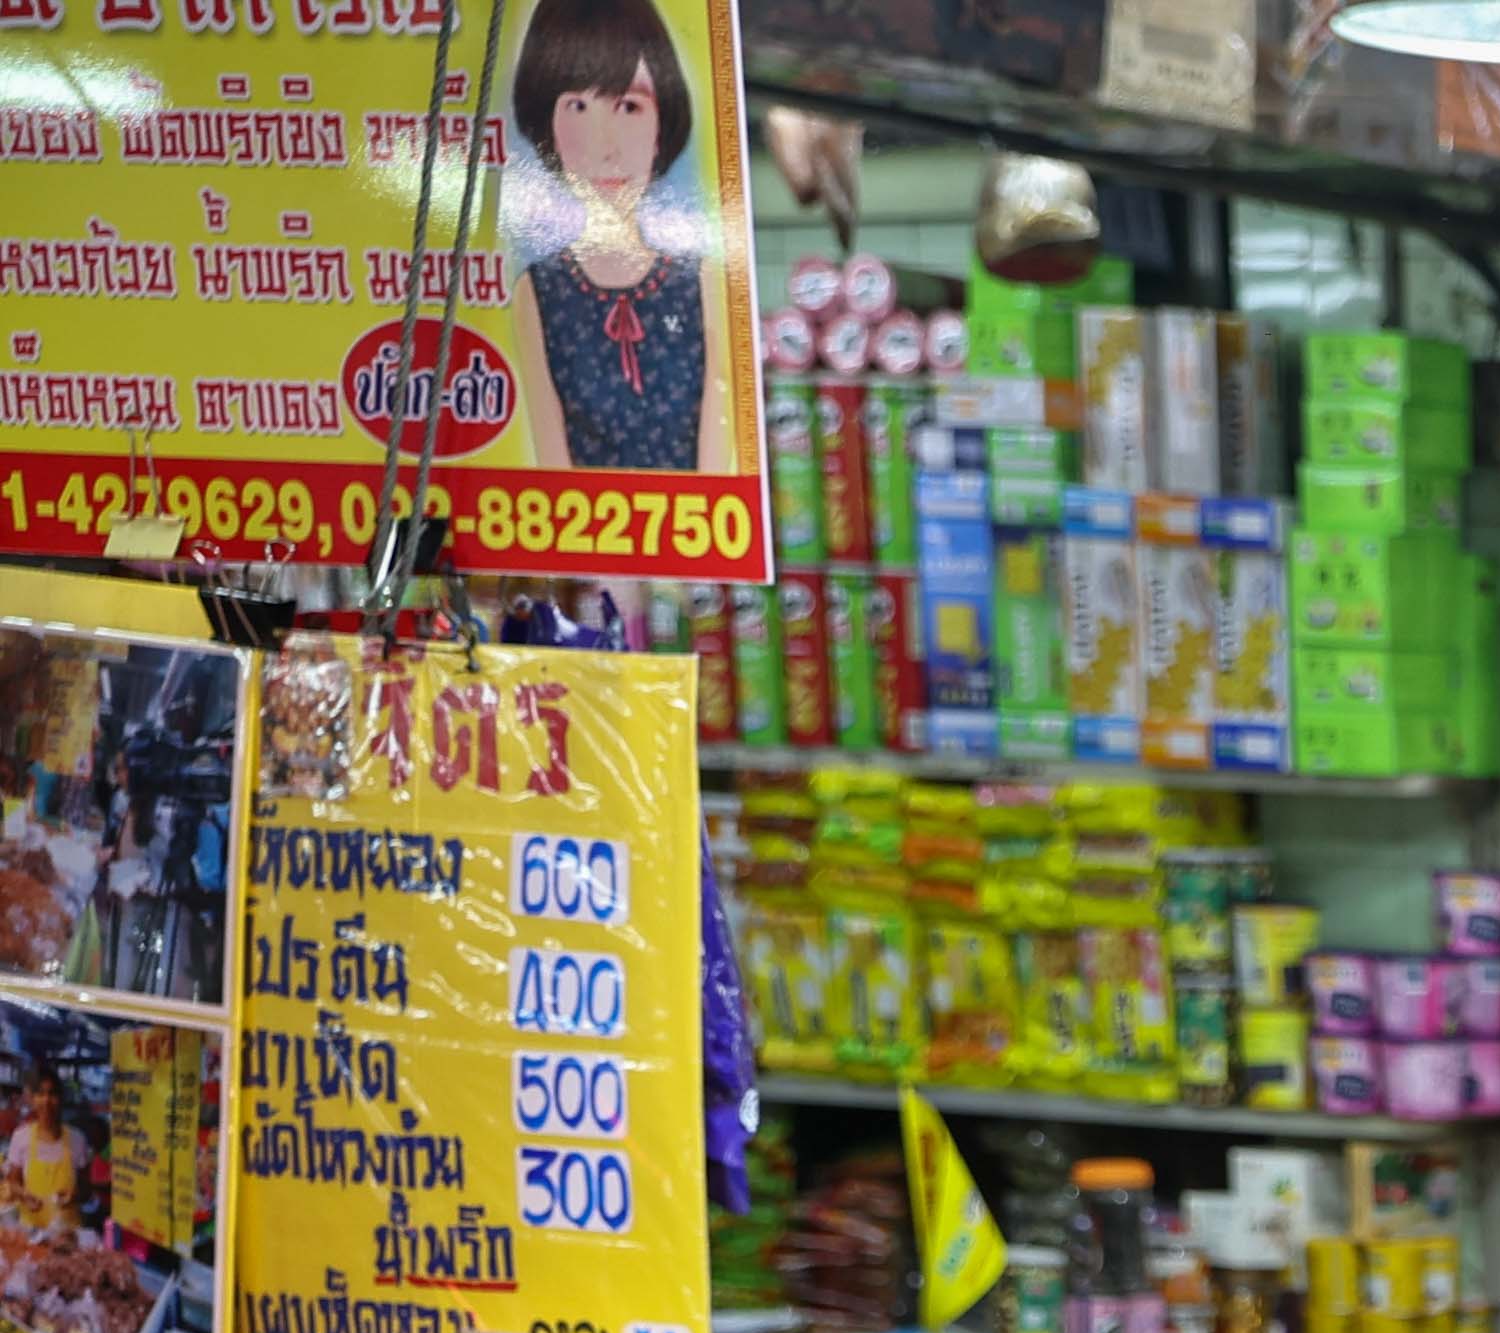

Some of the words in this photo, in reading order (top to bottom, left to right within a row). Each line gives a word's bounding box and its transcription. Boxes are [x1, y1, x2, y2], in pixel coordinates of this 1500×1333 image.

[194, 190, 352, 301] น้ำพริก
[196, 377, 343, 435] ตาแดง
[521, 835, 619, 920] 600
[515, 949, 621, 1034] 400
[517, 1055, 623, 1133] 500
[521, 1148, 631, 1231] 300
